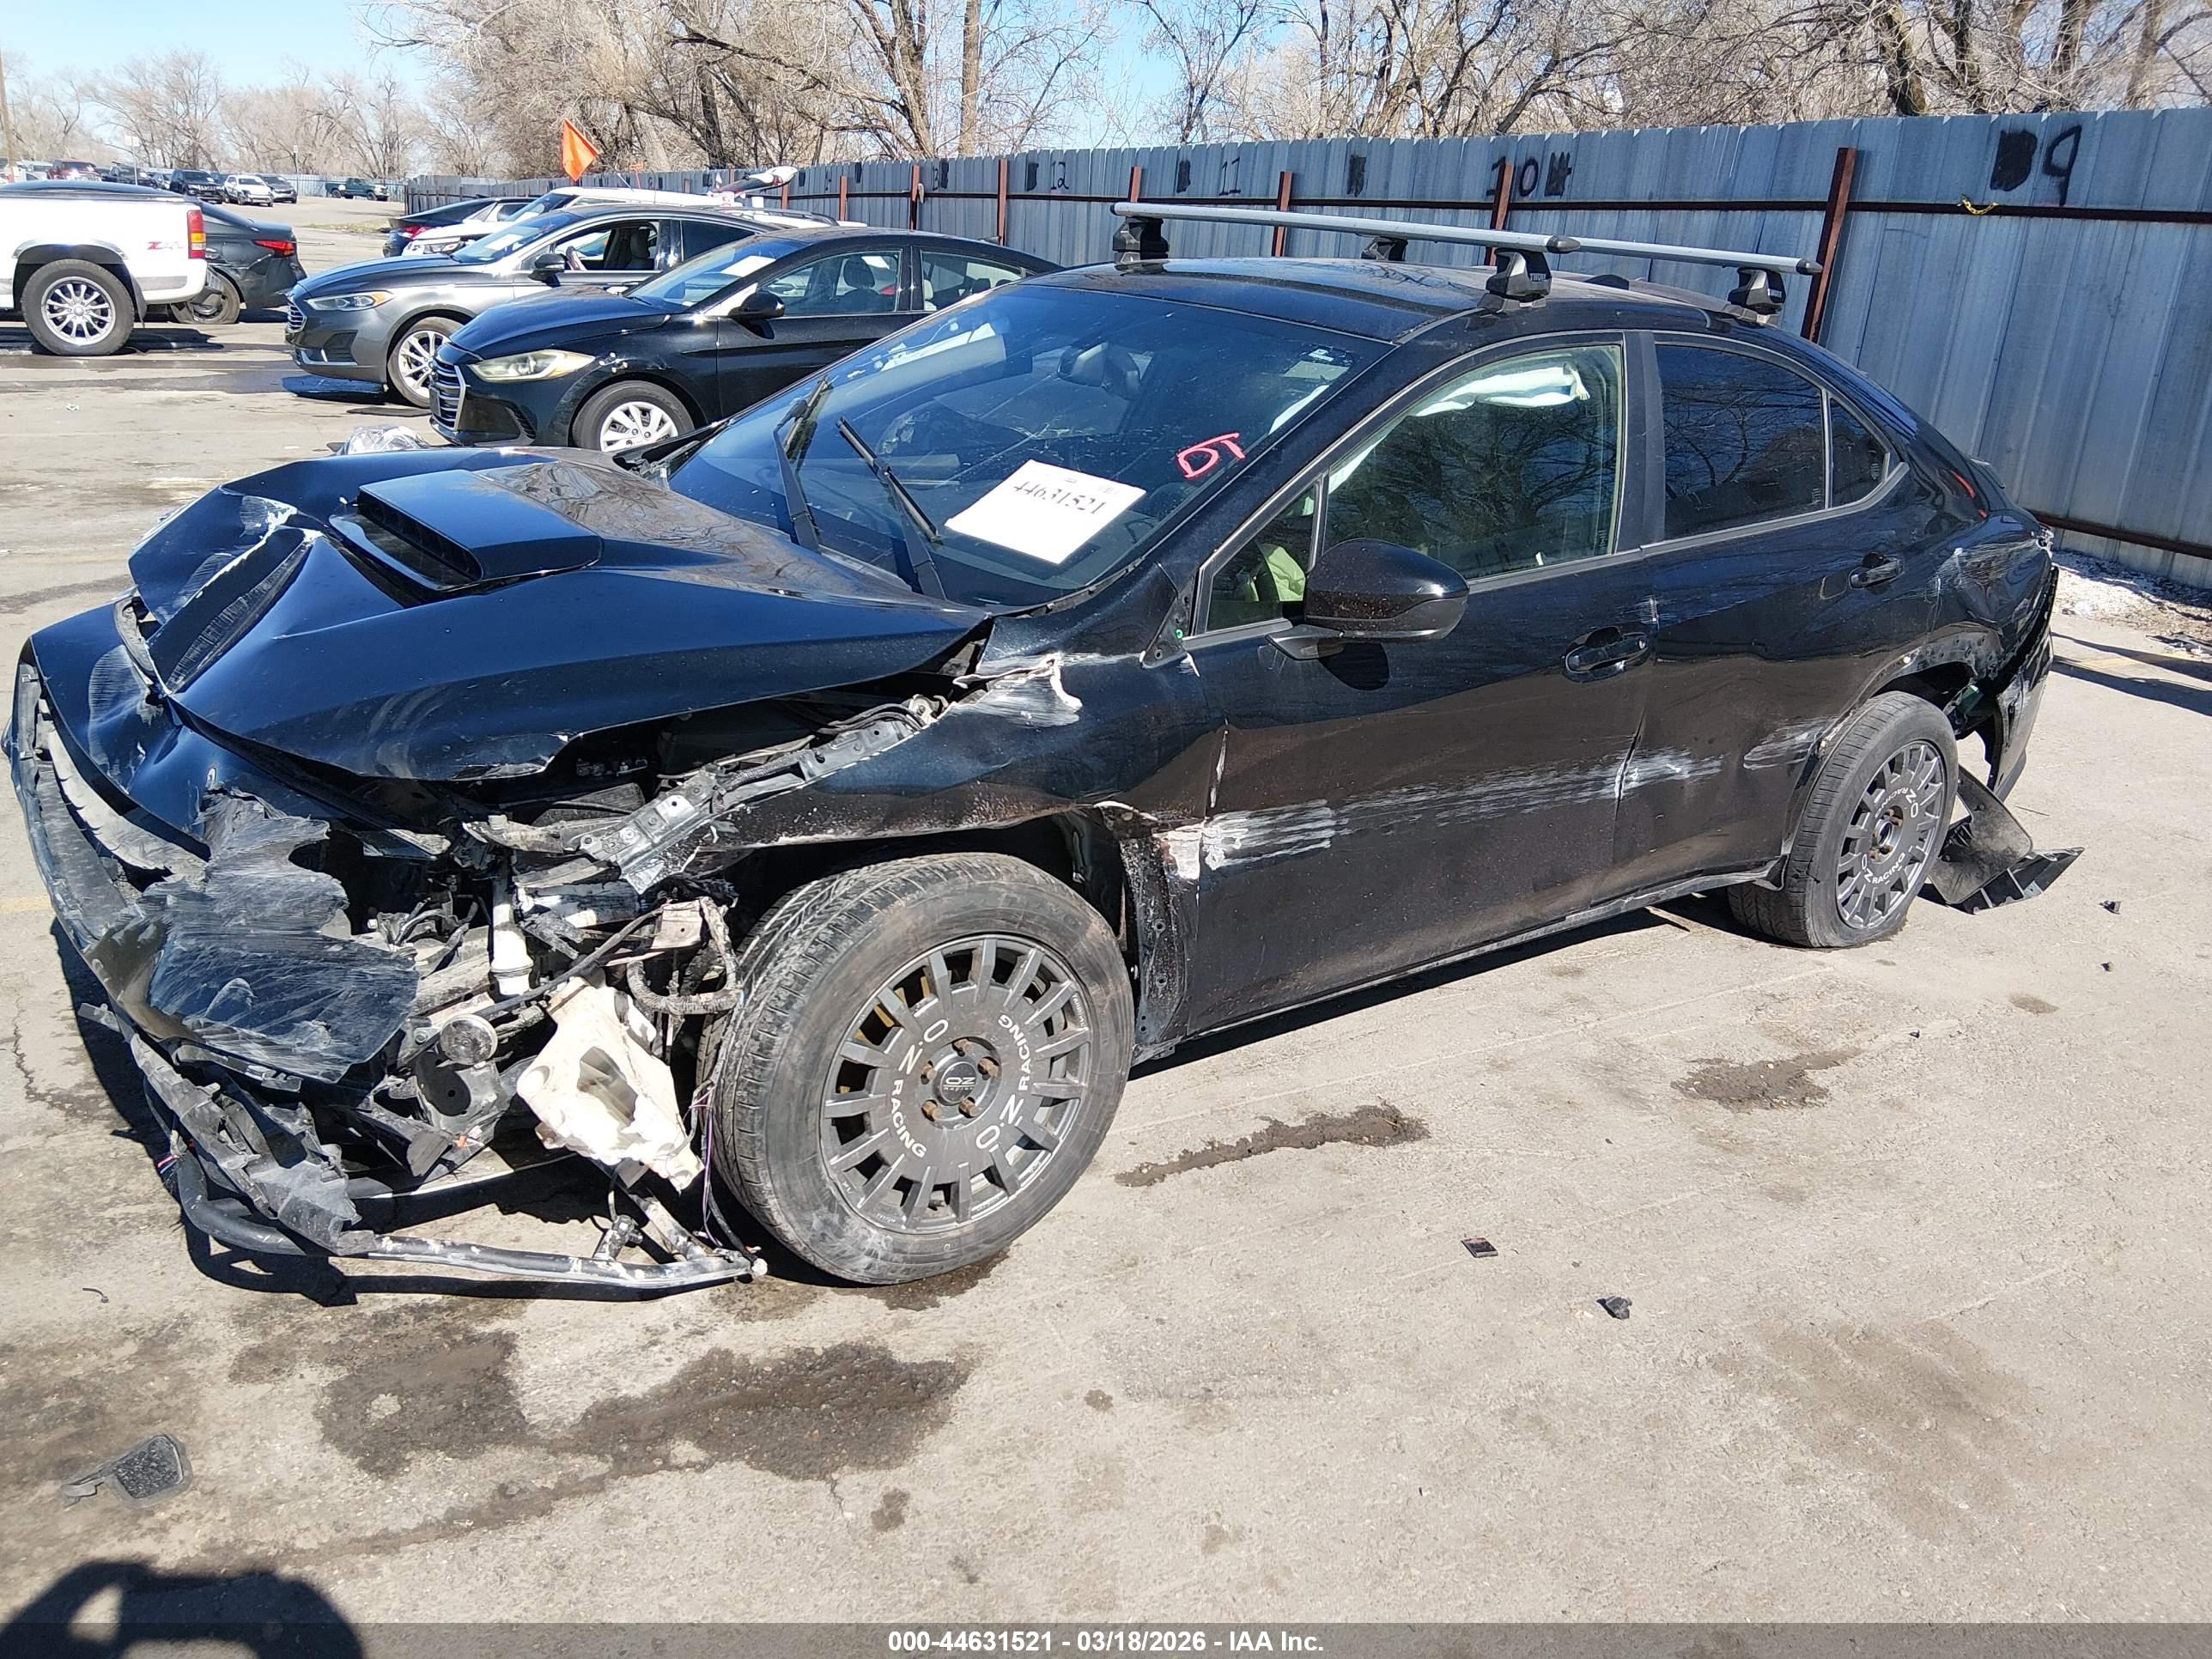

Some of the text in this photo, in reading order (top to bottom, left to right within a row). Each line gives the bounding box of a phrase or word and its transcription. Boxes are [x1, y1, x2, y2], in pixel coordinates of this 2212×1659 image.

[1050, 161, 1070, 191] 12
[1218, 156, 1242, 196] 11
[2042, 125, 2082, 206] 9
[1013, 481, 1107, 514] 44631521
[998, 1014, 1030, 1091] RACING
[891, 1079, 927, 1158] RACING
